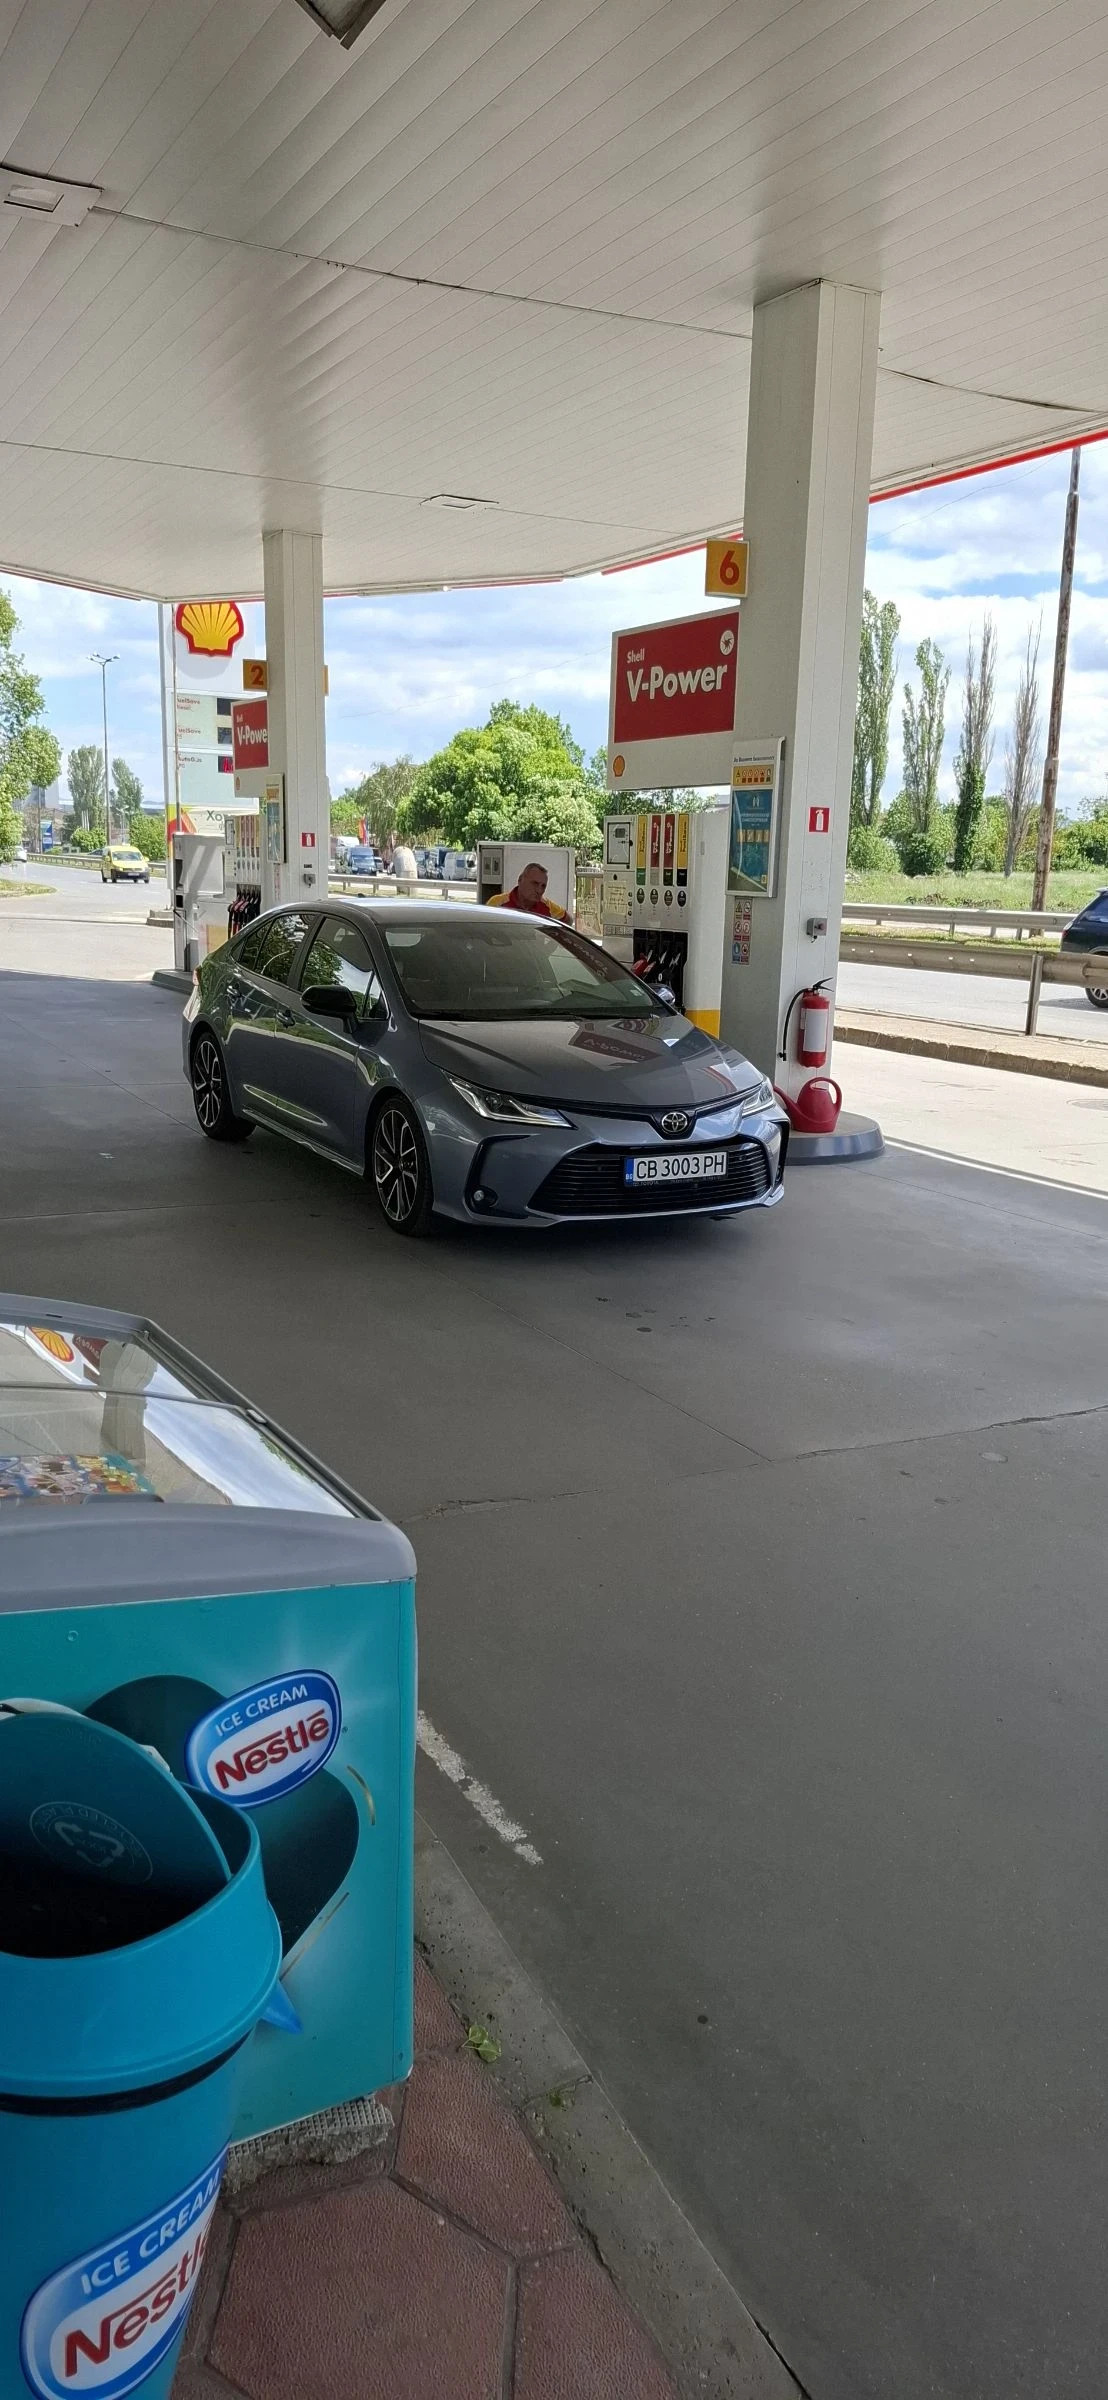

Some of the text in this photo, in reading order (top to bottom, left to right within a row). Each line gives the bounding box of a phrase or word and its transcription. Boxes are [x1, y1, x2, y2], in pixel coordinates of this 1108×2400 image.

[719, 550, 740, 586] 6
[626, 648, 645, 664] Shell
[250, 664, 264, 686] 2
[626, 664, 728, 702] V-Power
[236, 725, 268, 746] V-Powe
[636, 1154, 725, 1179] CB 3003 PH
[215, 1684, 308, 1738] ICE CREAM
[213, 1709, 331, 1790] Nestlé
[80, 2167, 220, 2295] ICE CREAM
[64, 2231, 206, 2379] Nestl
